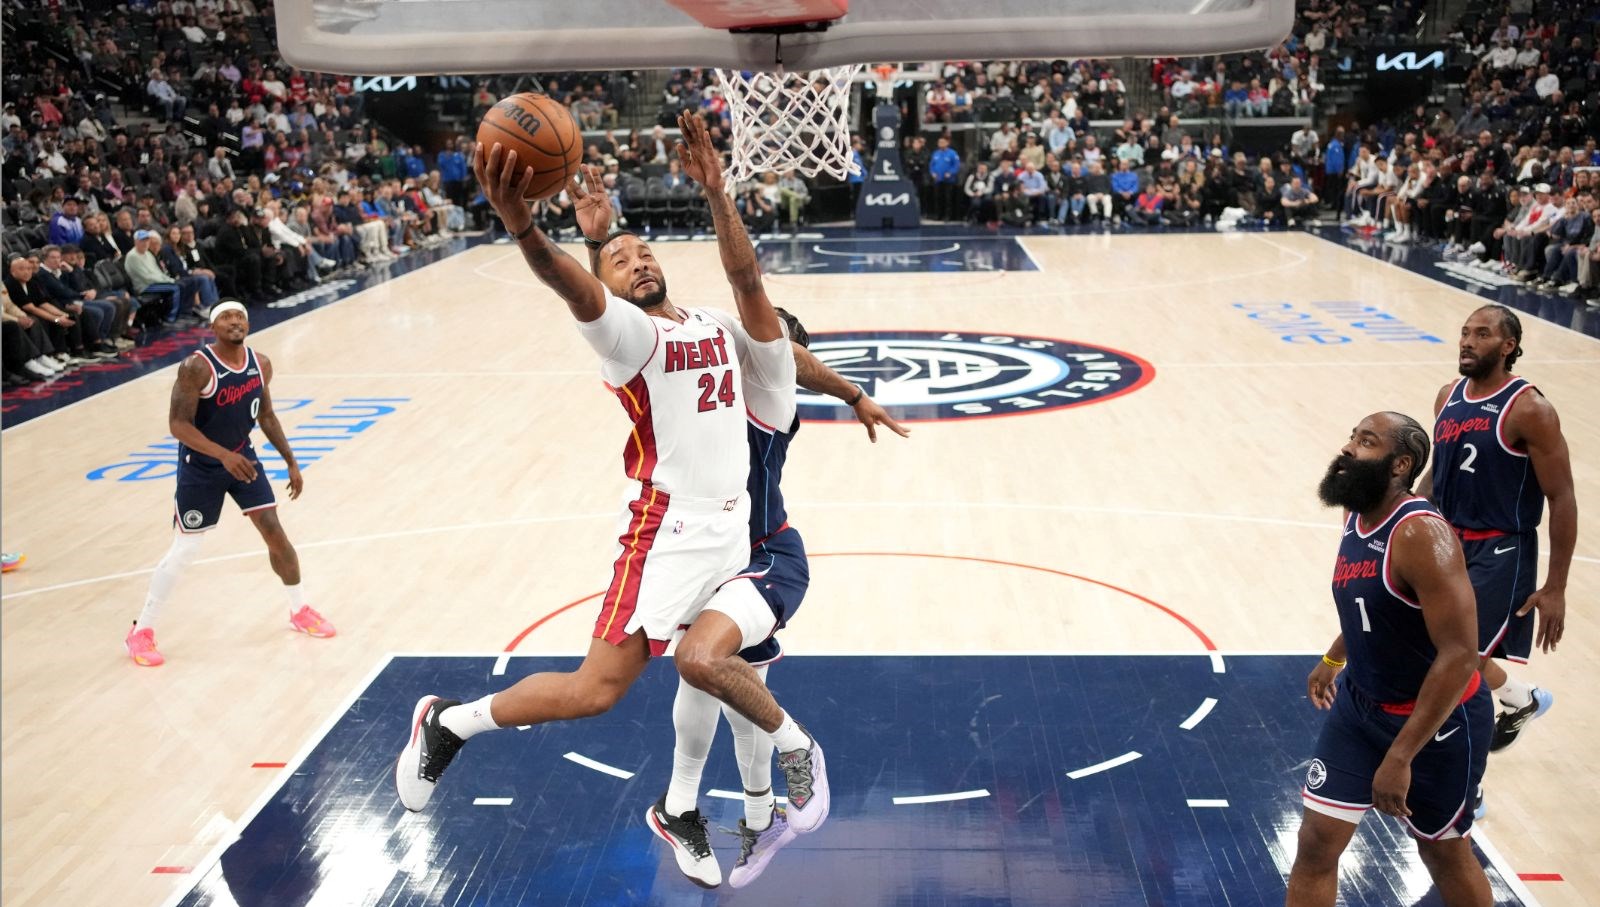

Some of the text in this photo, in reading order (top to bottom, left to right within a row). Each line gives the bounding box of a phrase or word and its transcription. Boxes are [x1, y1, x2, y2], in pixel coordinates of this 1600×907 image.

[664, 332, 729, 373] HEAT
[216, 376, 261, 407] Clippers
[697, 369, 736, 413] 24
[250, 397, 260, 419] 0
[1435, 417, 1490, 444] Clippers
[1459, 443, 1477, 473] 2
[1333, 555, 1377, 589] lippers
[1355, 597, 1371, 632] 1
